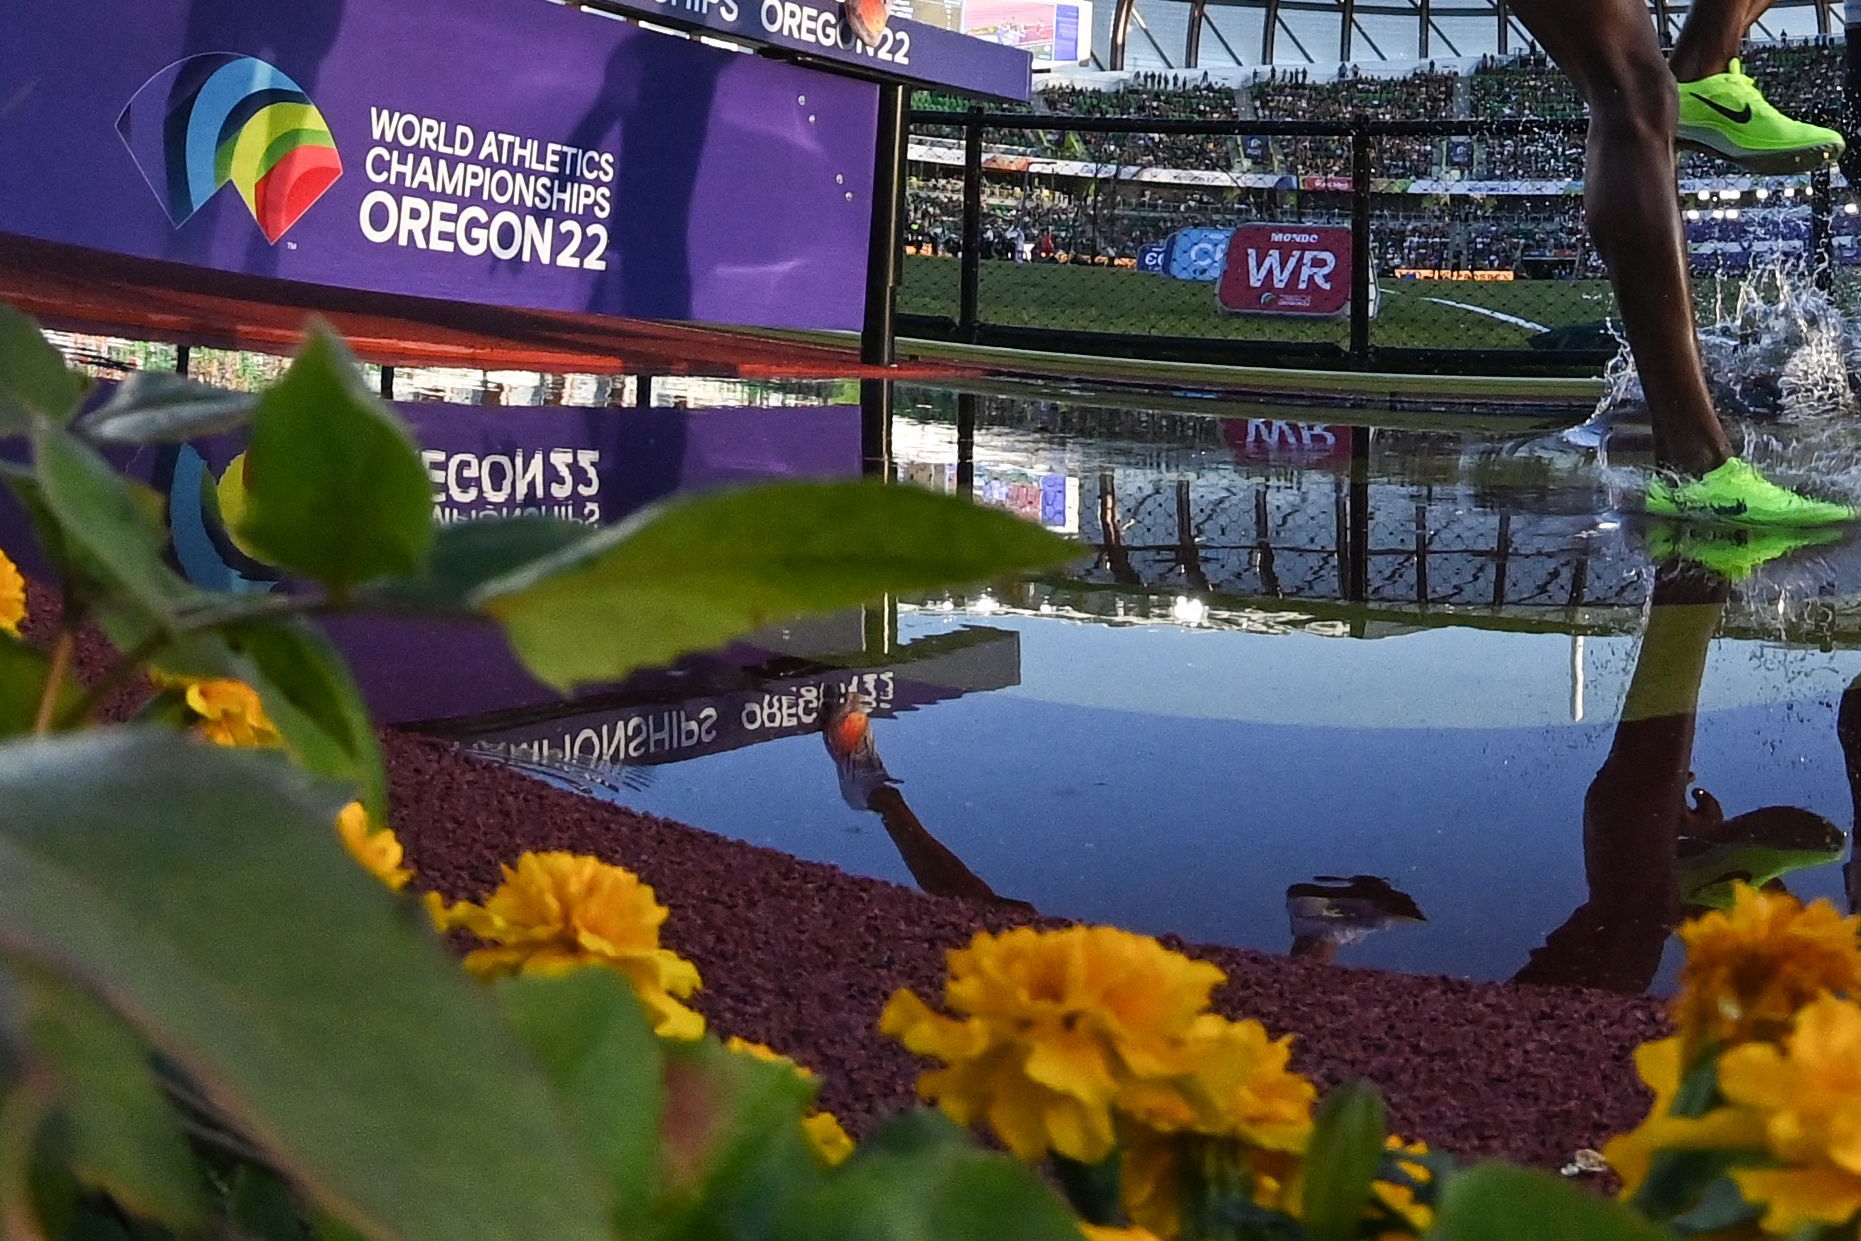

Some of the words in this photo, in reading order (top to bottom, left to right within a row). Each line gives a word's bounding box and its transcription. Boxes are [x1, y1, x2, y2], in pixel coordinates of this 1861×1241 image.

[371, 106, 474, 157] WORLD
[478, 131, 614, 183] ATHLETICS
[365, 146, 611, 219] CHAMPIONSHIPS
[359, 190, 608, 271] OREGON22
[1270, 232, 1319, 243] MONDO
[1247, 248, 1336, 291] WR
